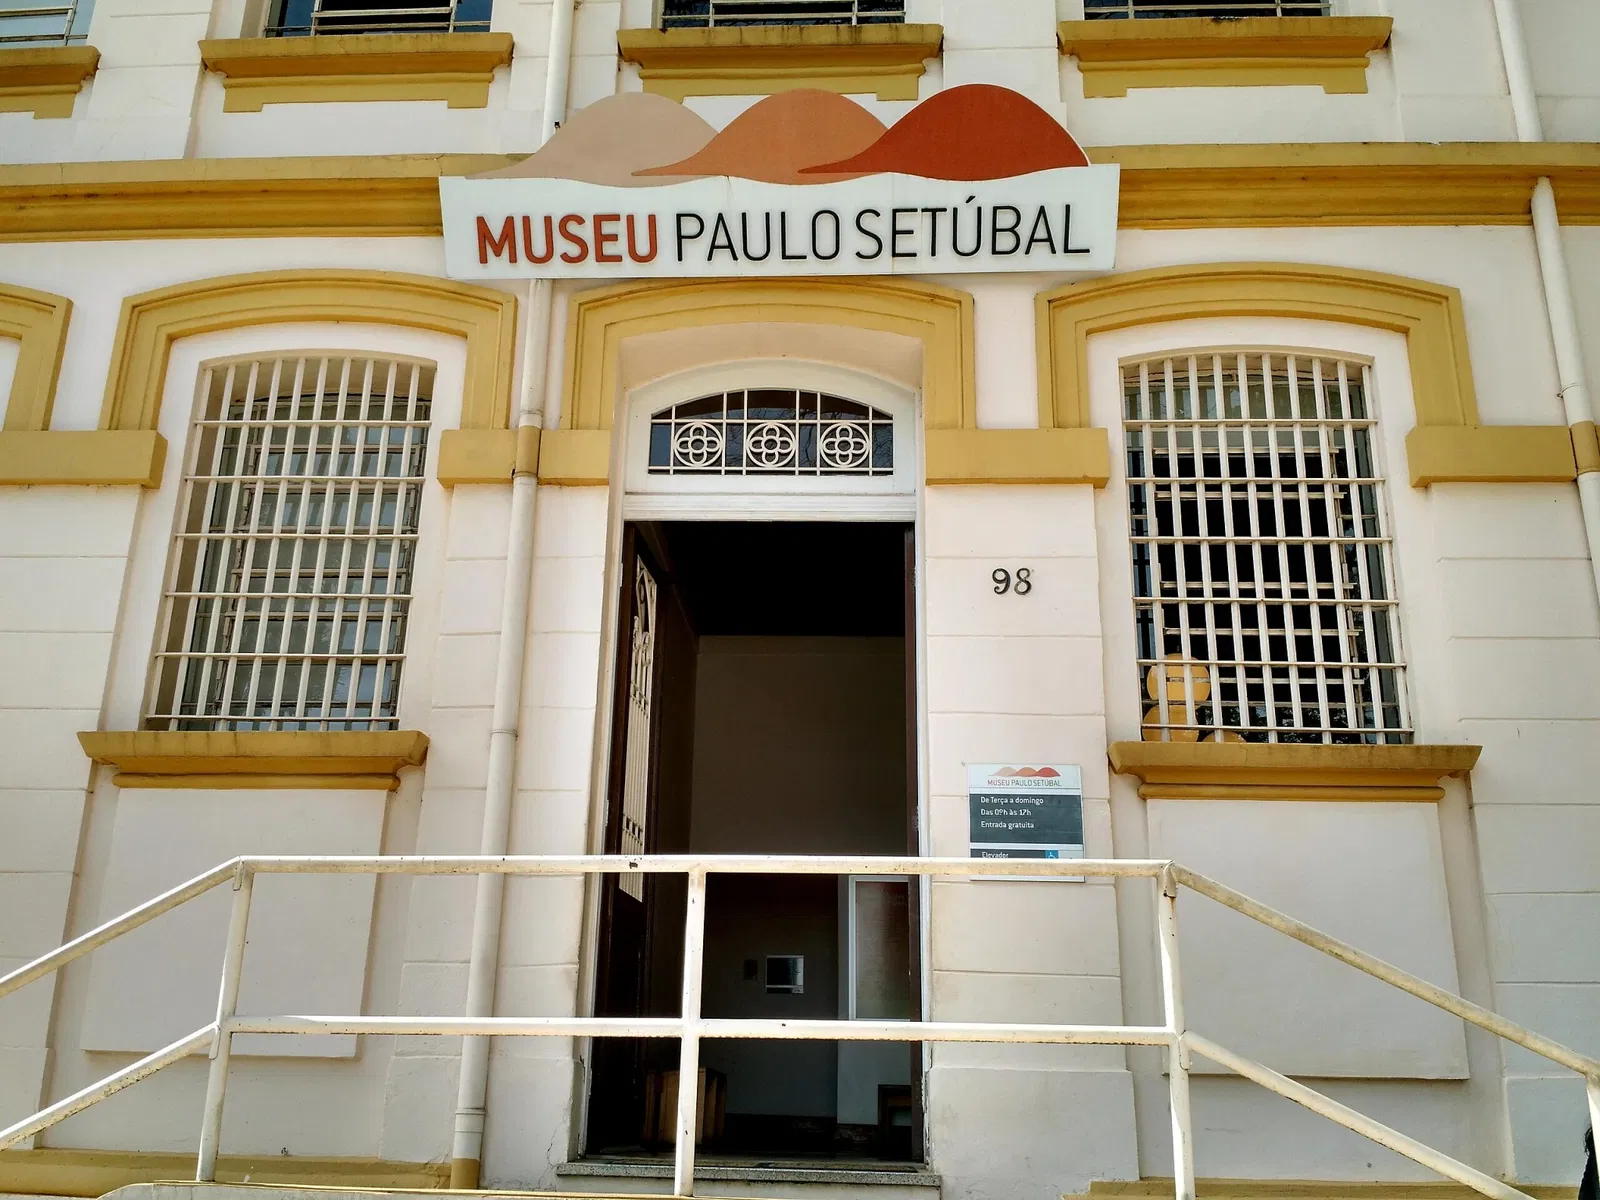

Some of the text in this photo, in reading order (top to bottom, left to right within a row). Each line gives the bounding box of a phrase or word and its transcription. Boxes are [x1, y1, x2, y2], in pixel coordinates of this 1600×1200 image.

[477, 195, 1091, 265] MUSEU PAULO SETÚBAL
[992, 568, 1032, 595] 98
[1033, 778, 1061, 786] SETÚBAL
[991, 796, 1008, 805] Terça
[1015, 797, 1044, 805] domingo
[1008, 821, 1034, 830] gratuita
